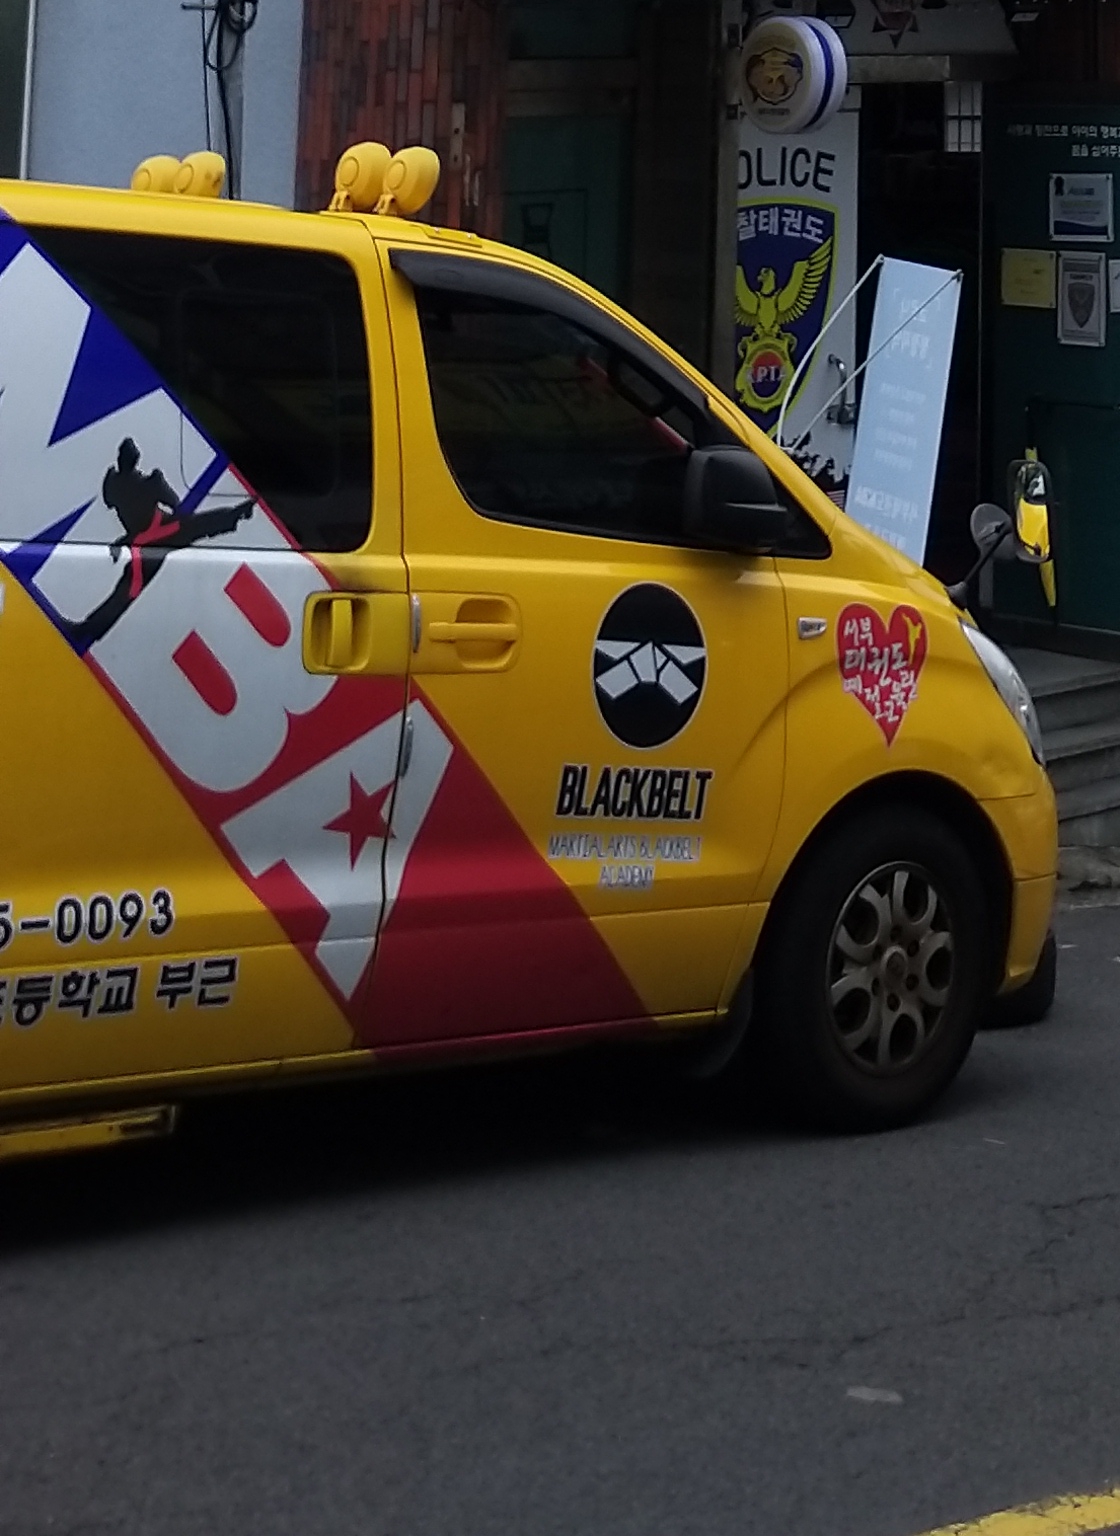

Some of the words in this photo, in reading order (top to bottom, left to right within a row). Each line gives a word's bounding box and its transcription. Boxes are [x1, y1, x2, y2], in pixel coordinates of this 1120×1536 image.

[843, 616, 873, 647] 서부
[555, 764, 713, 820] BLACKBELT
[0, 966, 140, 1026] 등학교
[156, 956, 238, 1009] 부근
